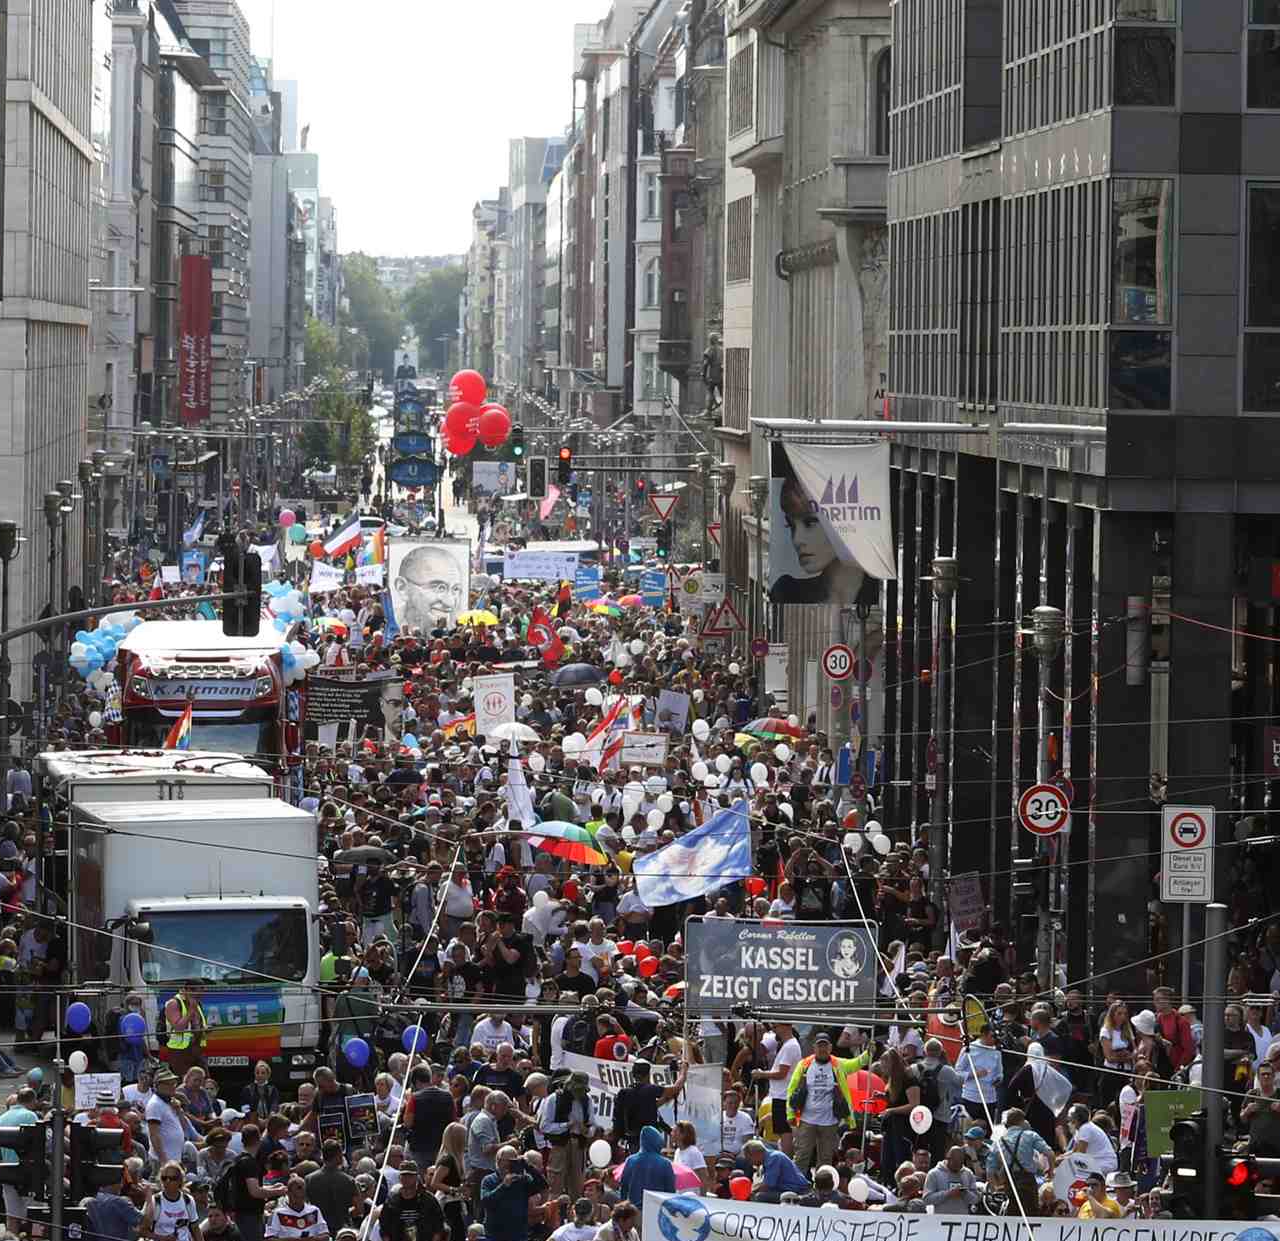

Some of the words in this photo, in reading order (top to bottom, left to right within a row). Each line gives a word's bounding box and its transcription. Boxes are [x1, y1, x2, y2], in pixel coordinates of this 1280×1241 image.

[829, 653, 848, 671] 30
[1029, 799, 1059, 822] 30
[738, 929, 773, 941] Corona
[776, 928, 817, 941] Rebellen
[740, 946, 819, 971] KASSEL
[699, 975, 762, 999] ZEIGT
[767, 977, 860, 1003] GESICHT
